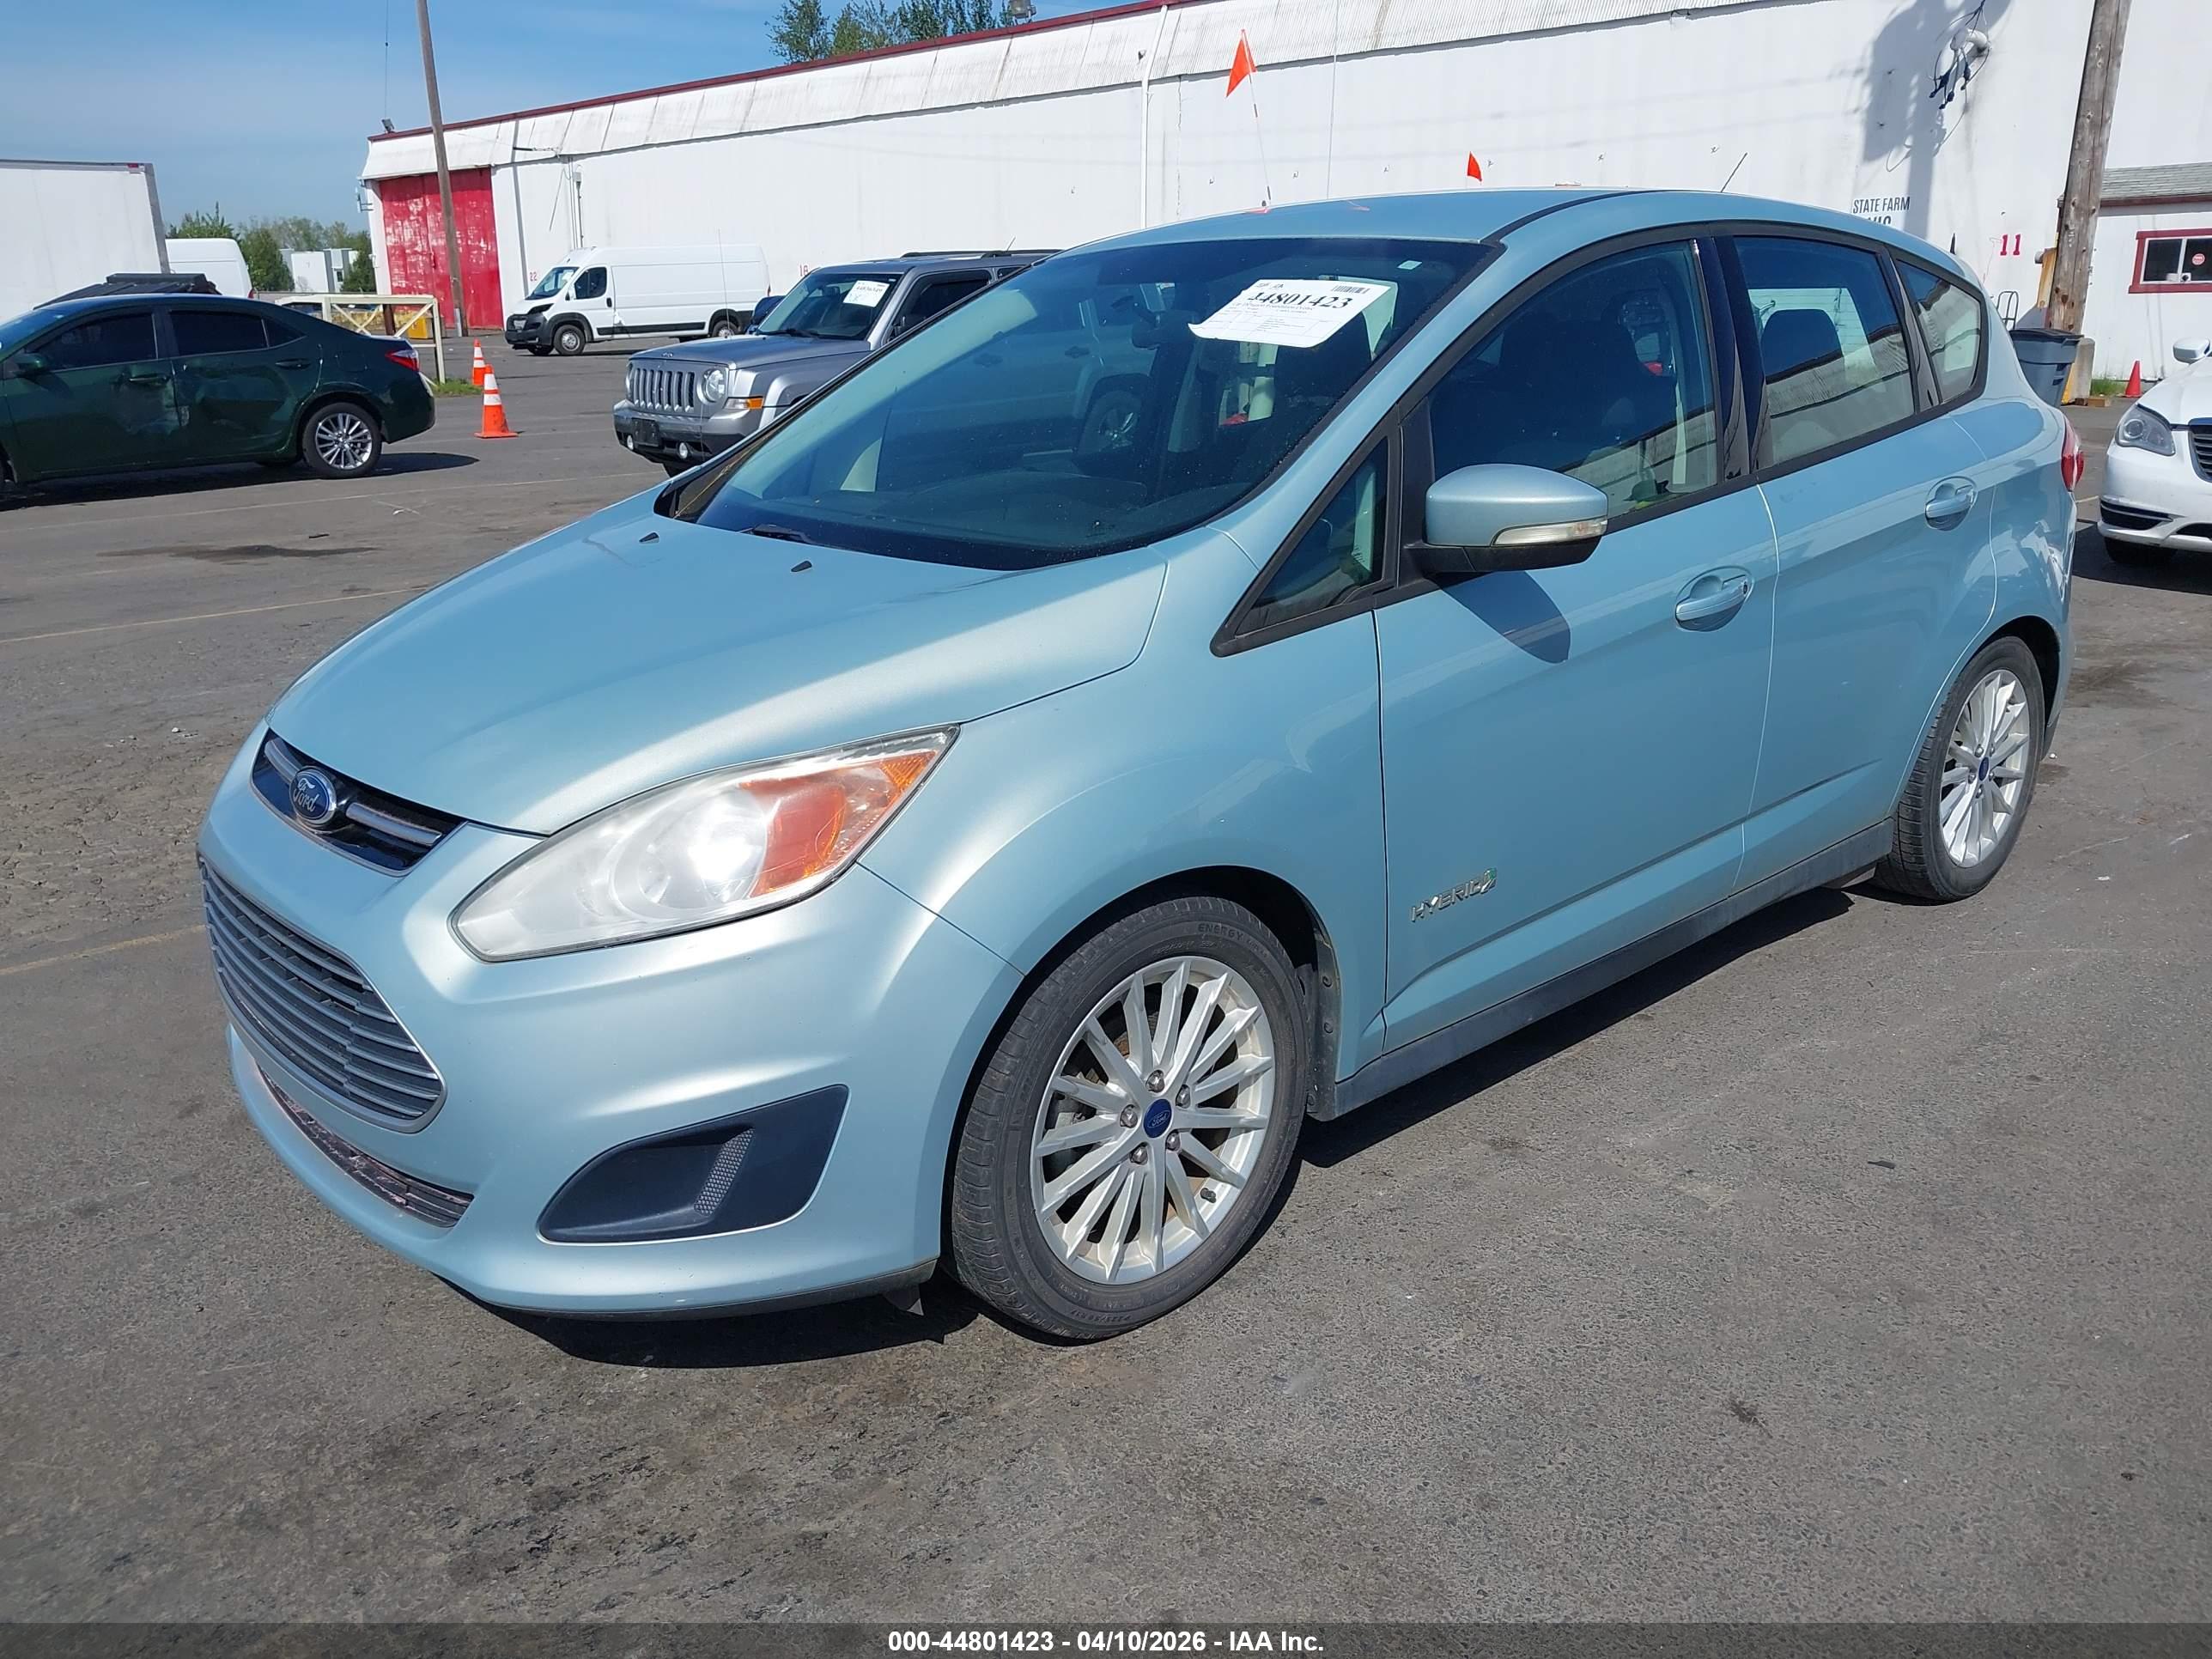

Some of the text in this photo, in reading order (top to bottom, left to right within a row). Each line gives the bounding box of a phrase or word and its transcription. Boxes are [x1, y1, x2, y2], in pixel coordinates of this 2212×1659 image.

[1853, 196, 1911, 214] STATE FARM
[2000, 234, 2021, 256] 11
[292, 777, 320, 812] Ford
